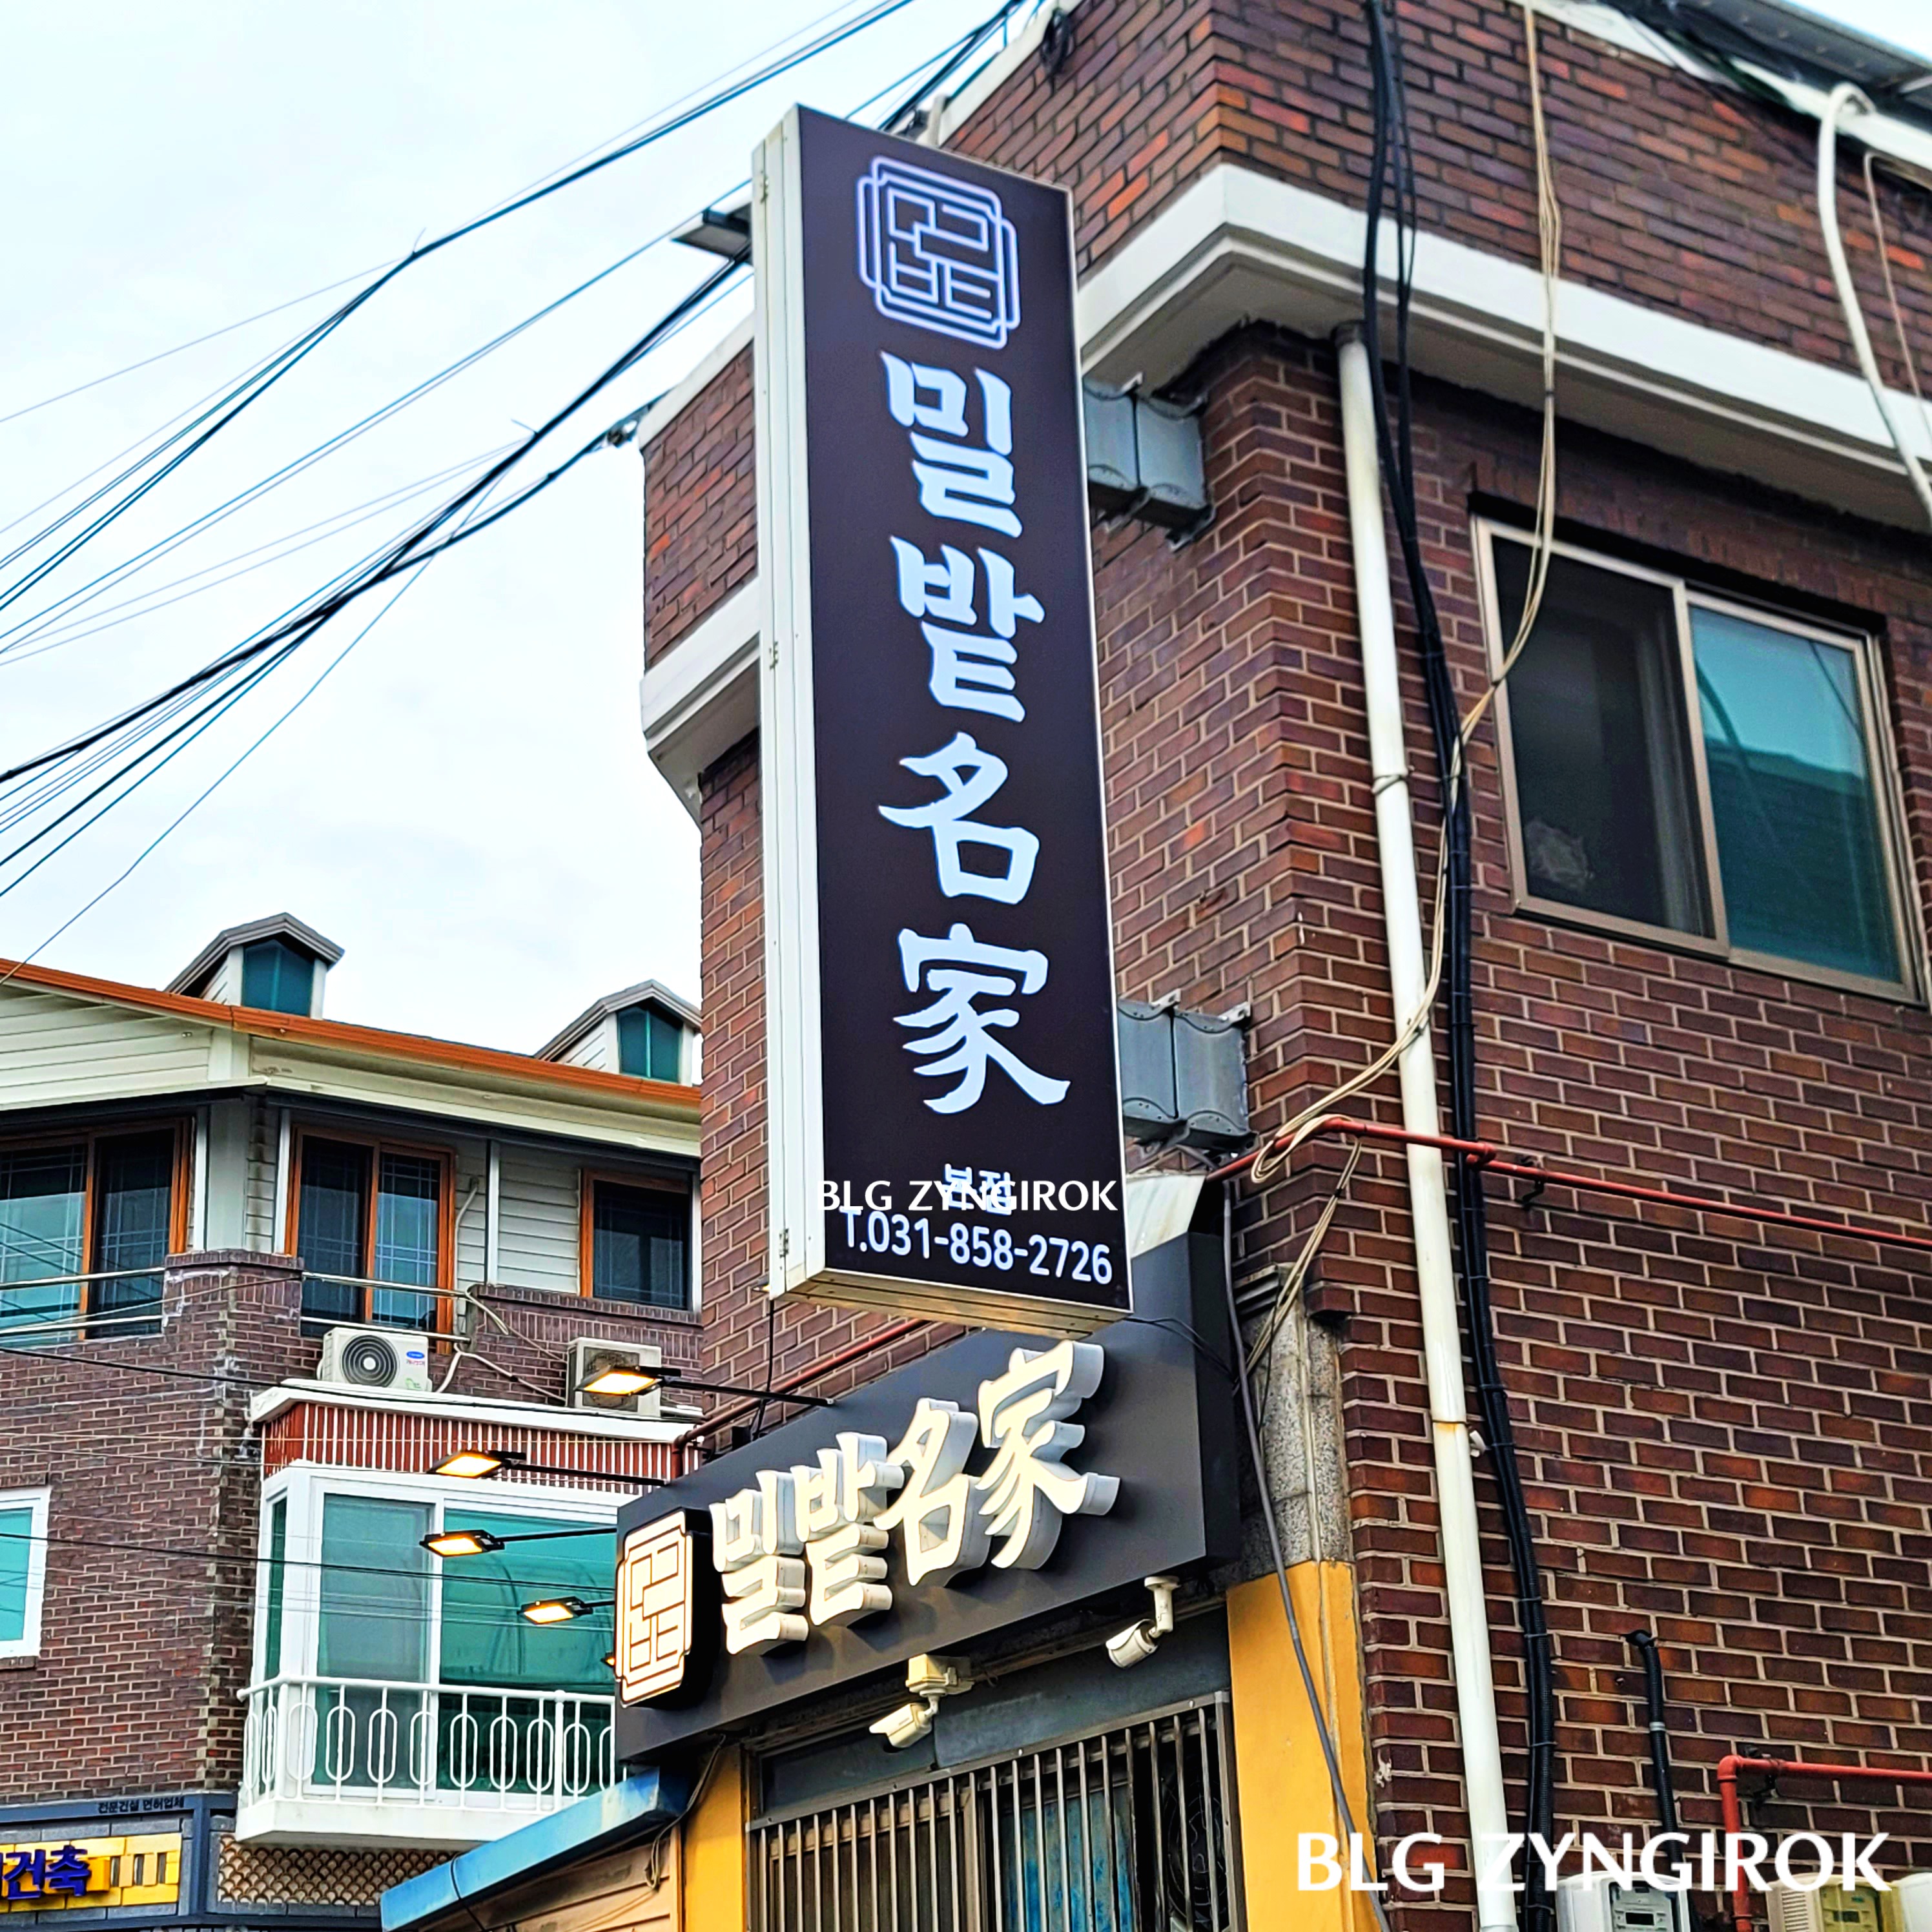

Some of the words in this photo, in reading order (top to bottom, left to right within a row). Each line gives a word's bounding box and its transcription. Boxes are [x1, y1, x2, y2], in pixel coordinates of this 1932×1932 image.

[879, 351, 1071, 1114] 밀밭名家
[839, 1206, 1113, 1285] T.031-858-2726
[708, 1340, 1120, 1655] 밀밭名家
[0, 1844, 92, 1900] 건축
